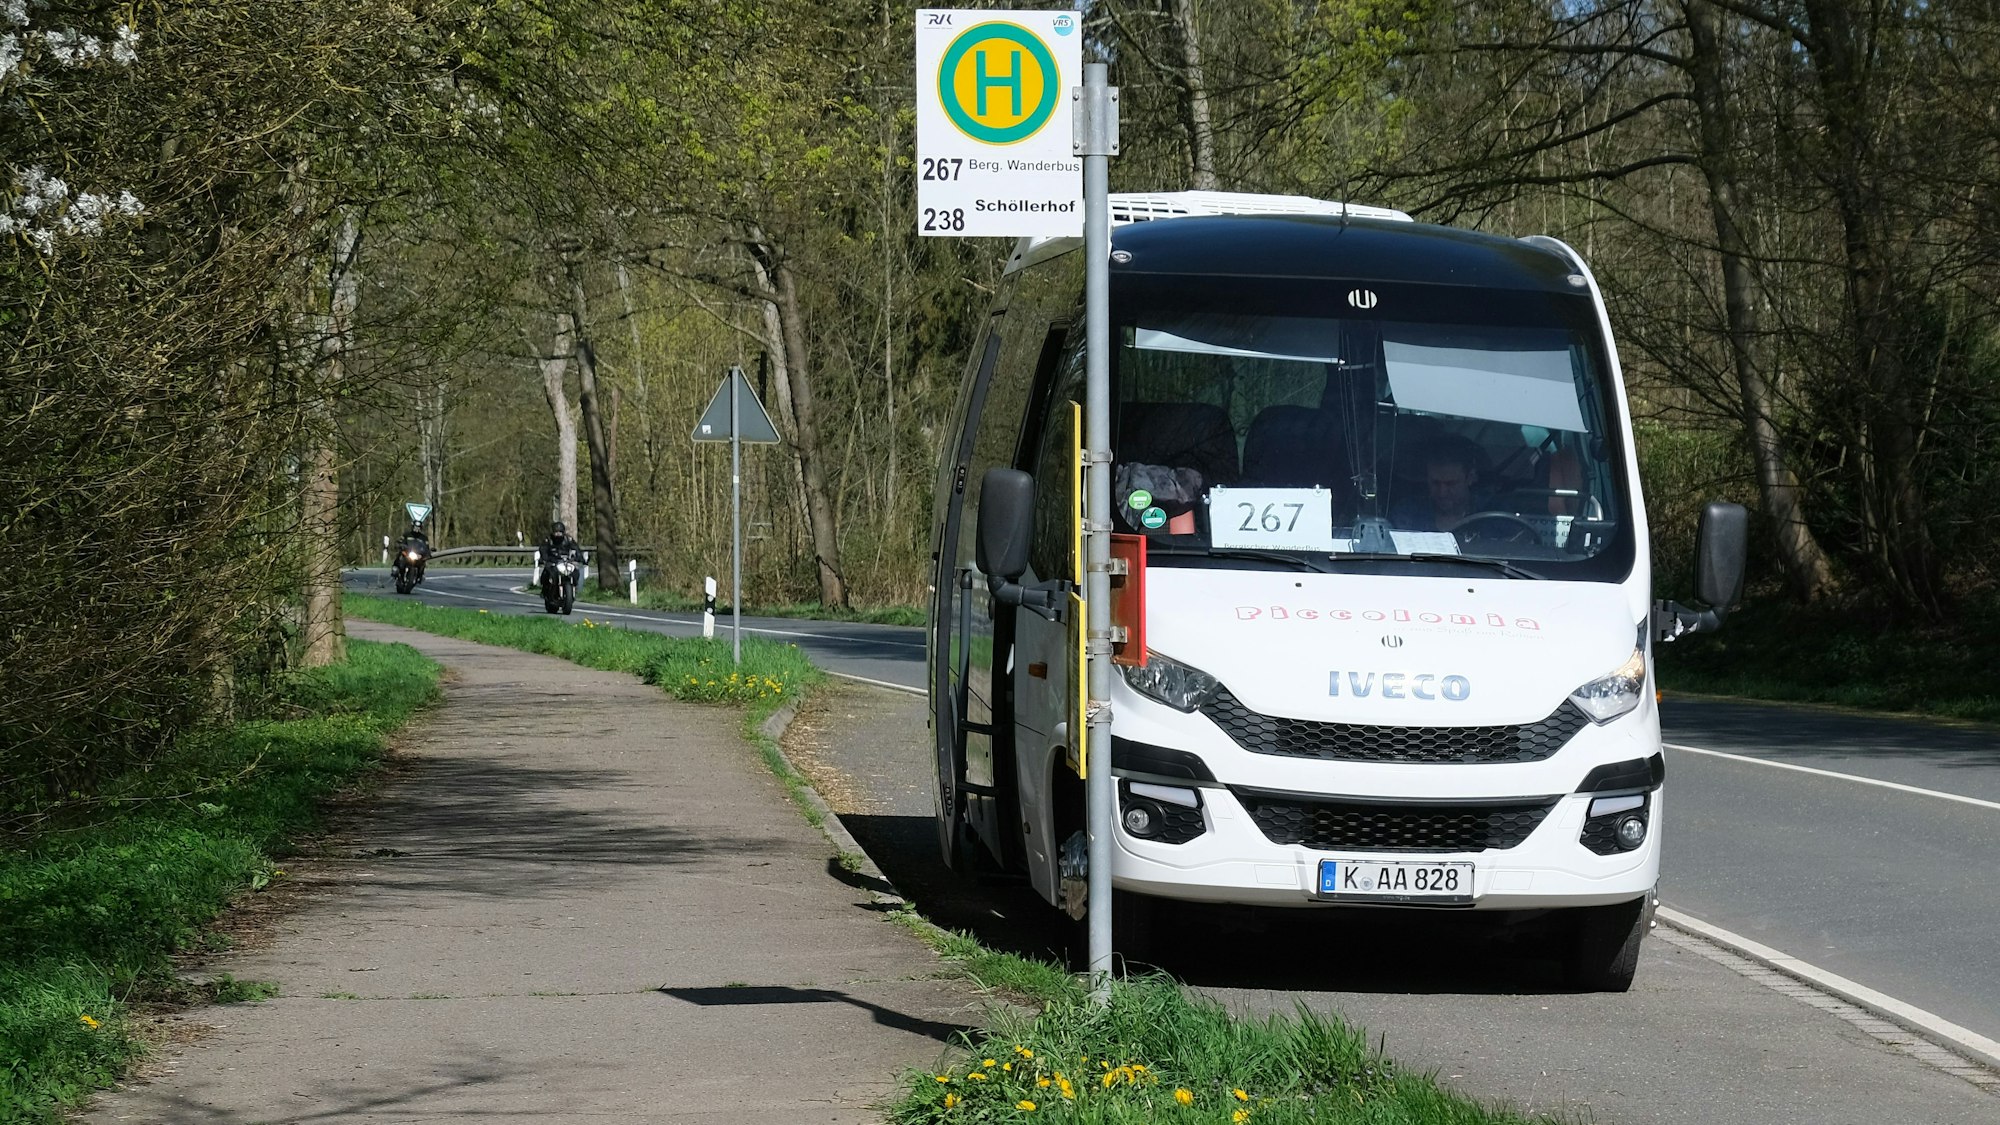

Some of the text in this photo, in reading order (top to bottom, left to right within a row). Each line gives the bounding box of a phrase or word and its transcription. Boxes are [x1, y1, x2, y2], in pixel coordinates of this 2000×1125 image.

[975, 51, 1022, 116] H
[922, 158, 1080, 181] 267 Berg. Wanderbus
[975, 199, 1075, 213] Schöllerhof
[923, 207, 965, 231] 238
[1237, 502, 1304, 533] 267
[1235, 606, 1540, 630] Piccolonia
[1328, 671, 1471, 701] IVECO
[1344, 866, 1359, 889] K
[1377, 867, 1408, 891] AA
[1414, 868, 1459, 891] 828
